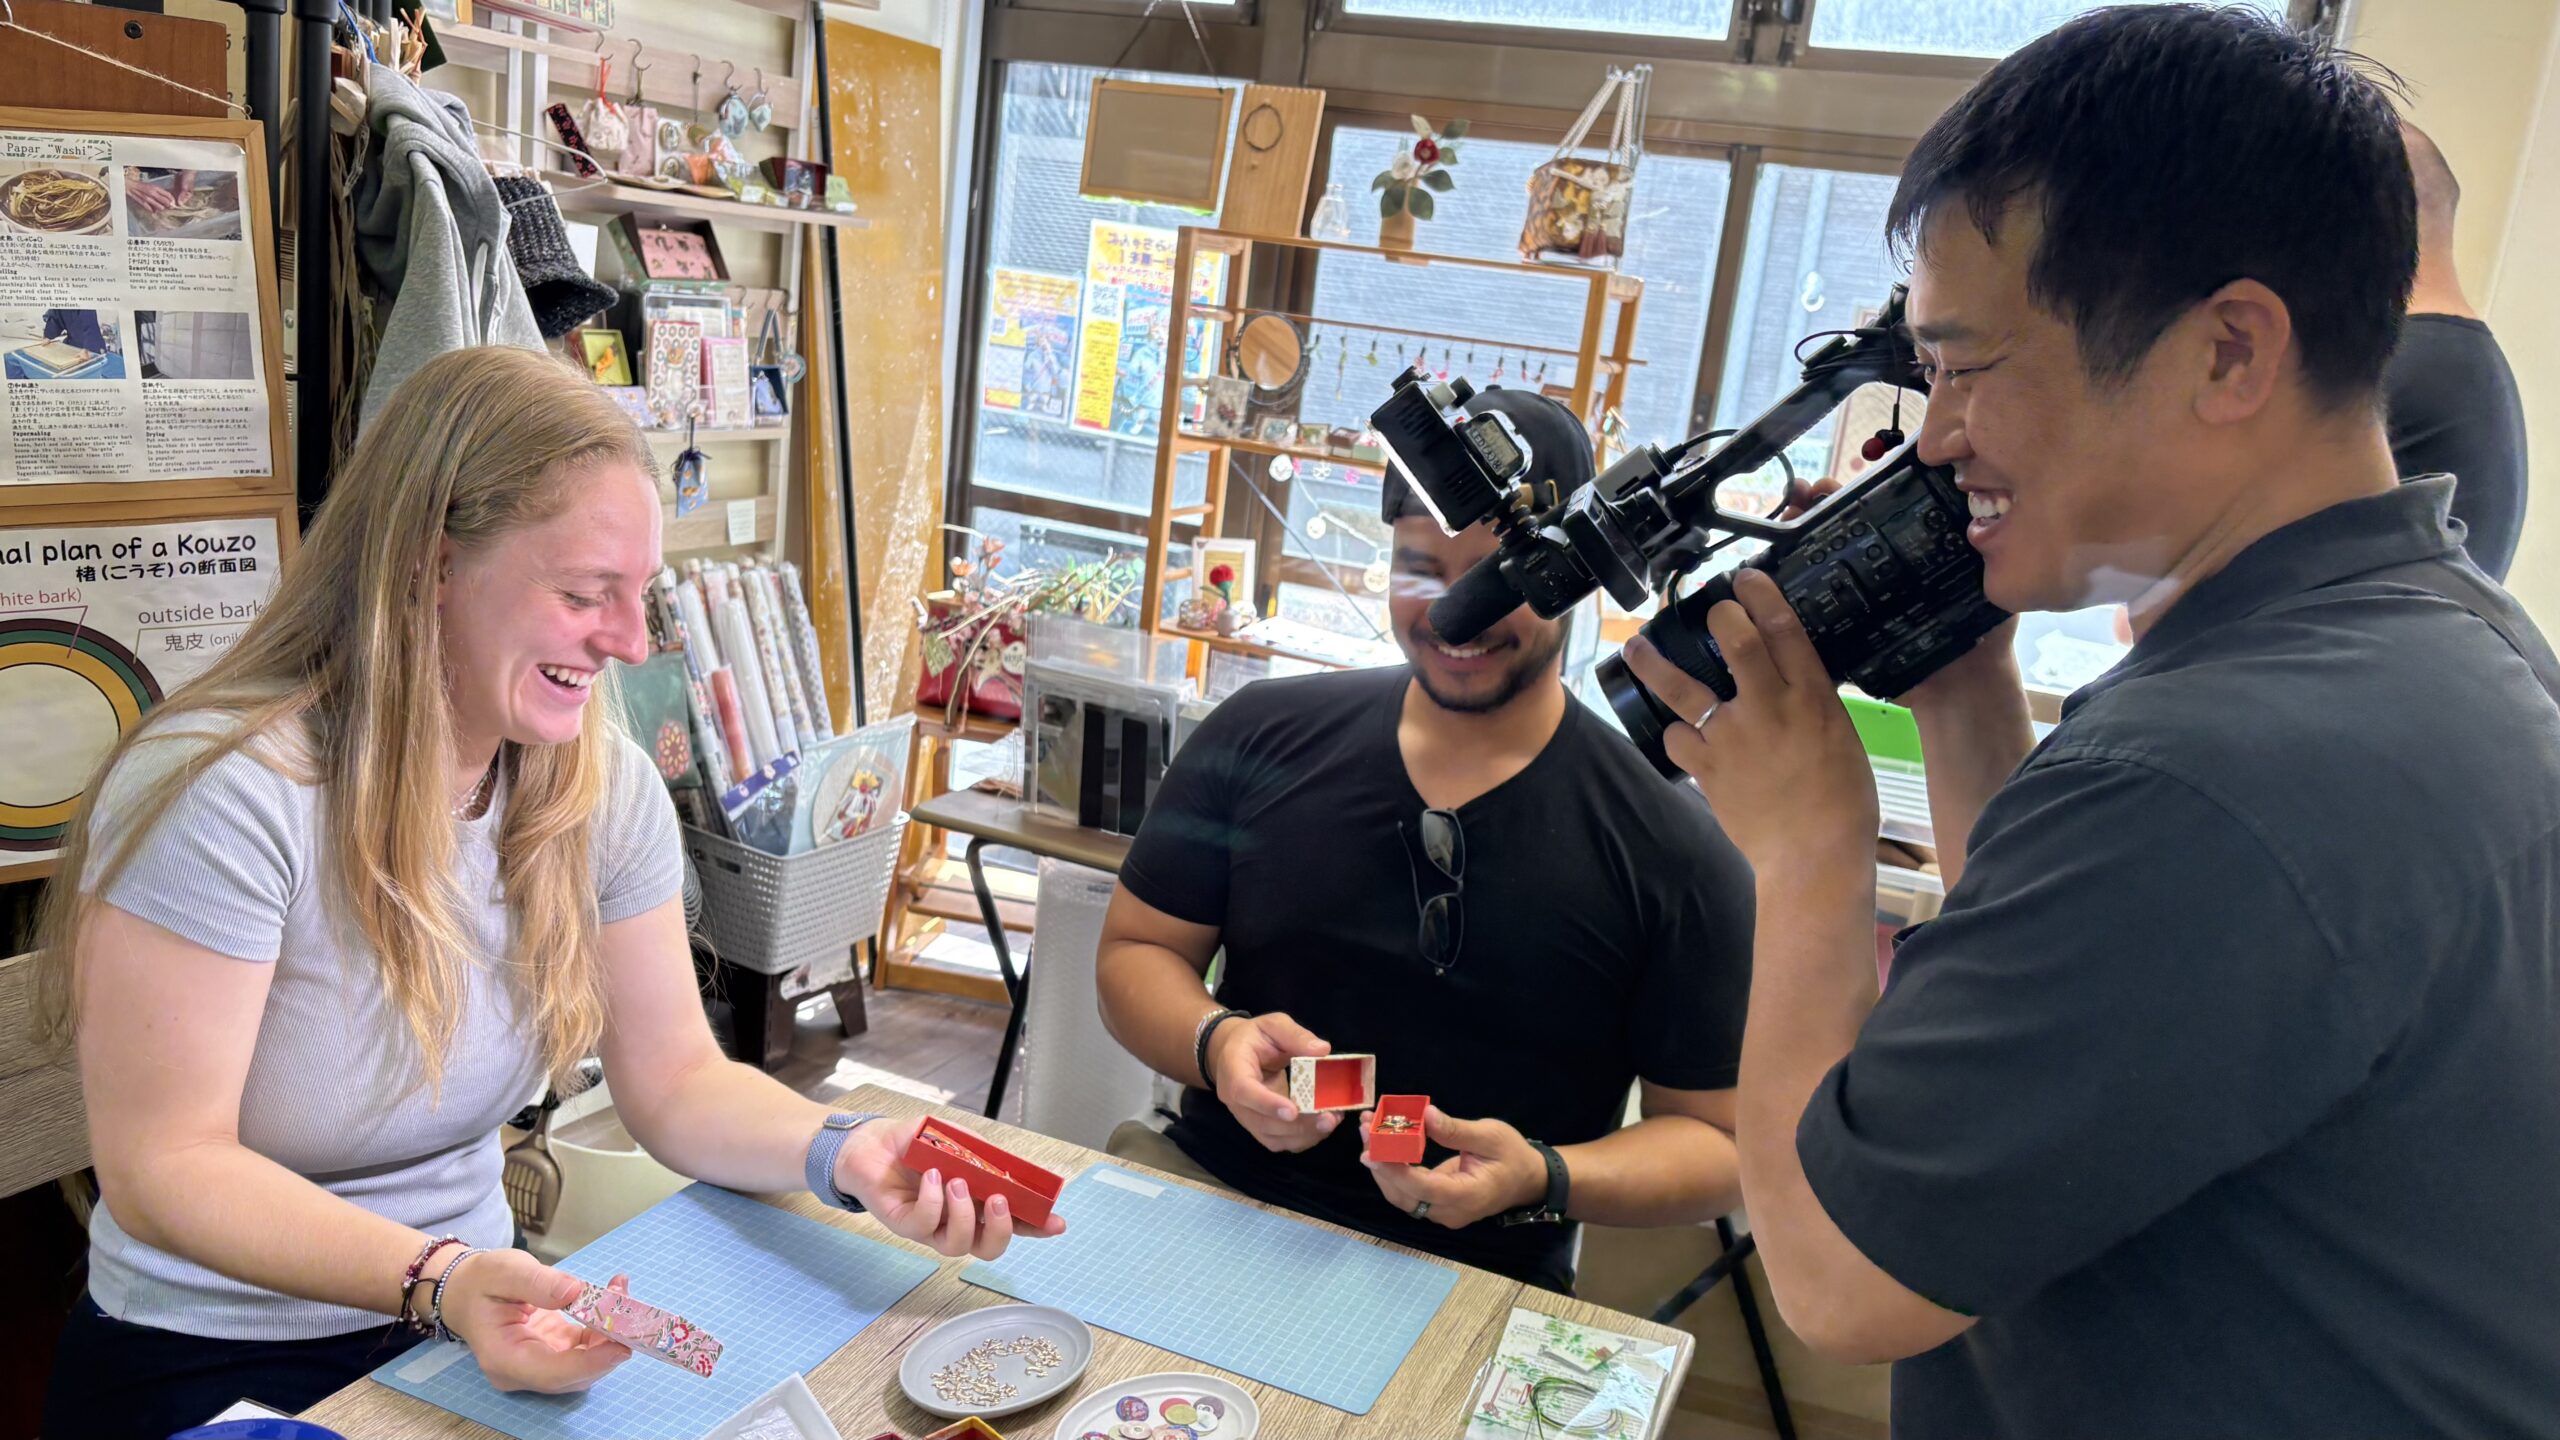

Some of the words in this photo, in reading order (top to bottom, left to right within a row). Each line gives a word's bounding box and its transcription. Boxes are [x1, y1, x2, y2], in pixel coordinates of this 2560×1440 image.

[7, 142, 40, 154] Papar
[43, 539, 102, 565] plan
[112, 537, 142, 559] of
[152, 542, 168, 557] a
[178, 534, 256, 556] Kouzo
[39, 587, 82, 604] bark)
[138, 603, 214, 624] outside
[165, 633, 205, 652] 鬼皮
